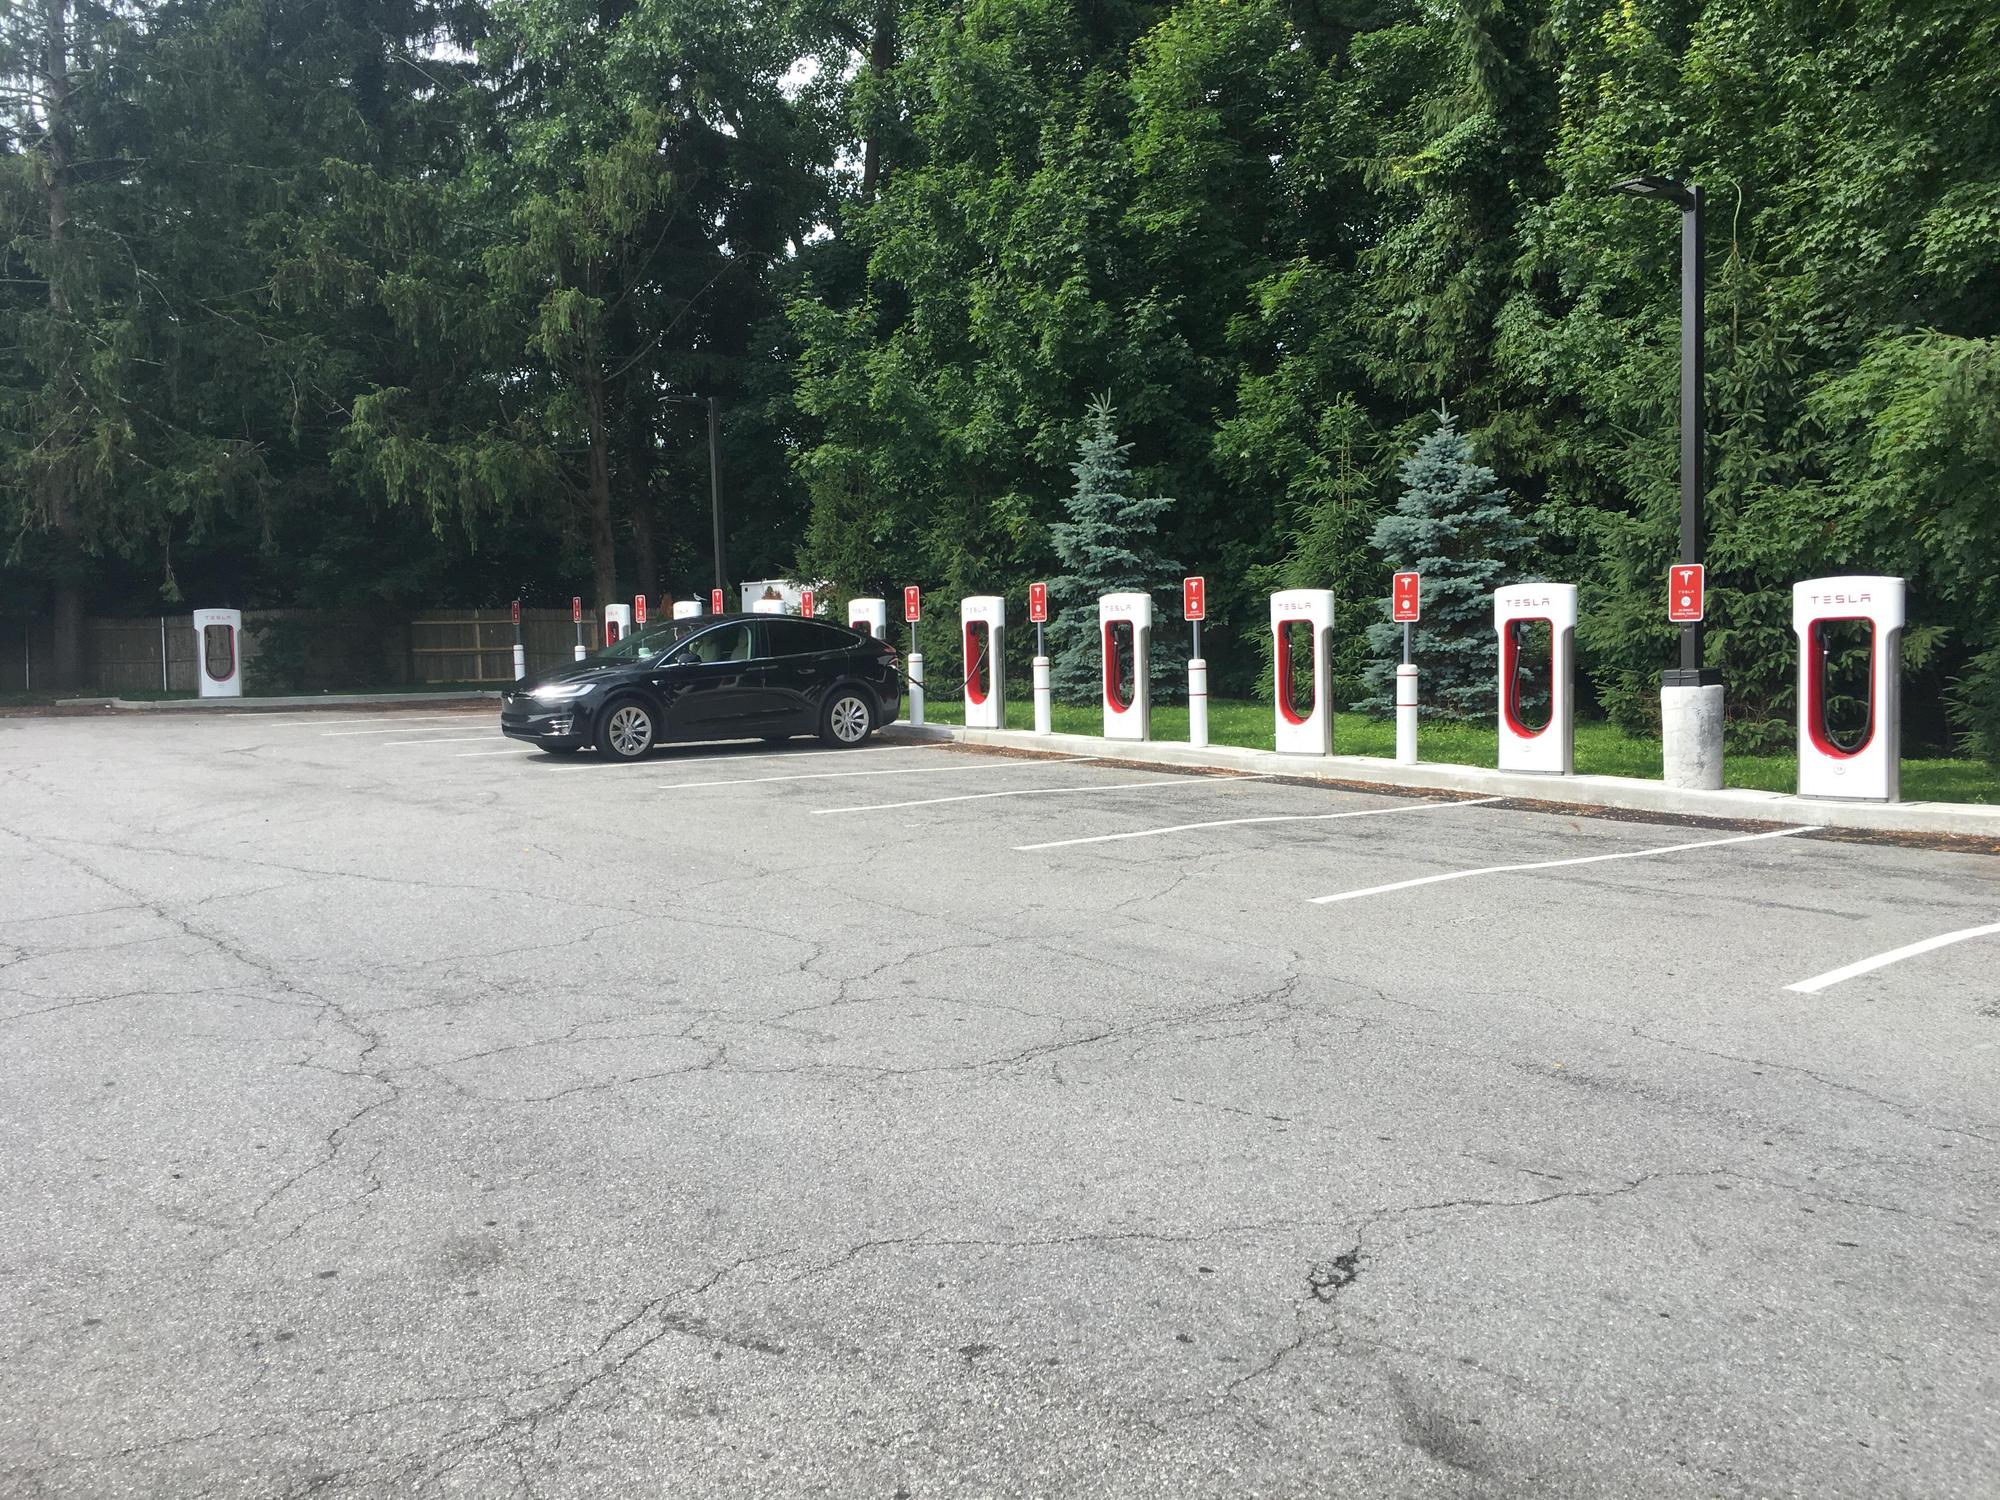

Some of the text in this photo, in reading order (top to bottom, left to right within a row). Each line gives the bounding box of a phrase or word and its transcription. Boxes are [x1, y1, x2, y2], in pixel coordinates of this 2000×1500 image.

[1506, 598, 1550, 606] TESLA
[1811, 594, 1871, 604] TESLA
[1278, 602, 1311, 610] TESLA
